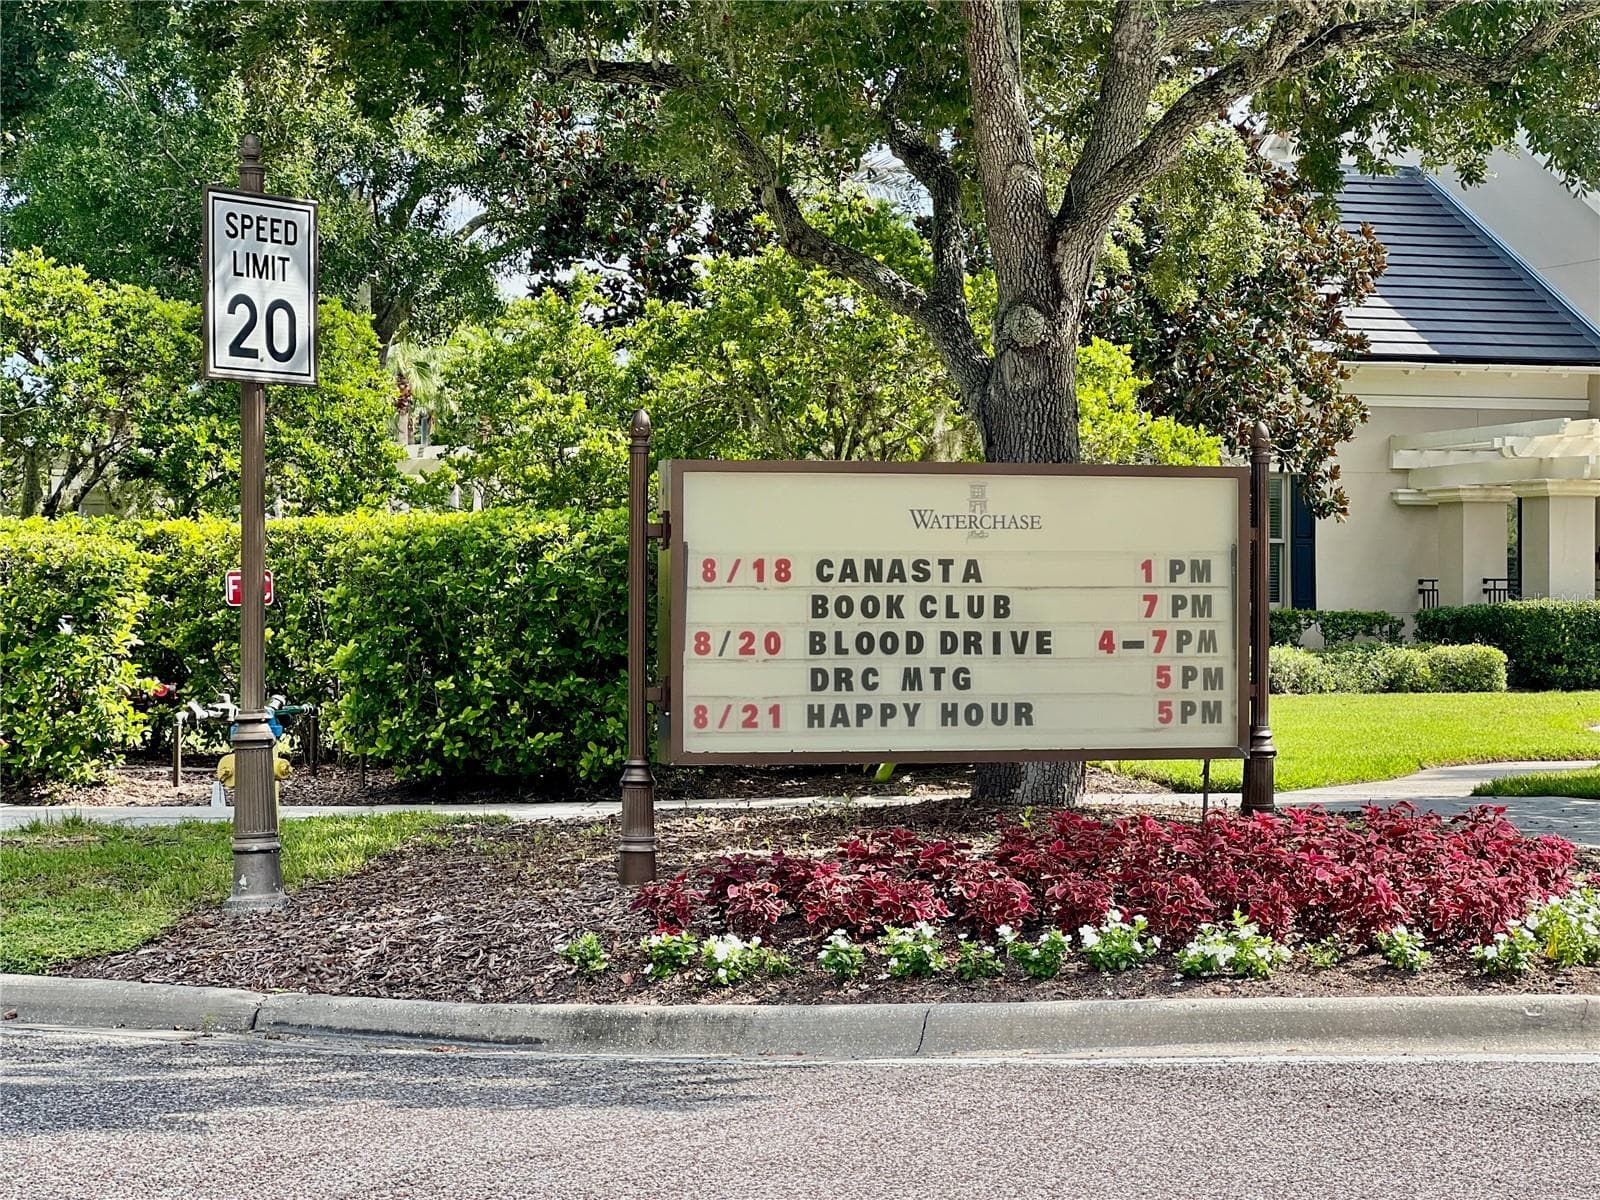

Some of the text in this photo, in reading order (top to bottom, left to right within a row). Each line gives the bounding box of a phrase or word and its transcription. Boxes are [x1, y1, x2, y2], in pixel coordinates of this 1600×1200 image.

[225, 212, 298, 246] SPEED
[232, 250, 290, 282] LIMIT
[227, 293, 297, 363] 20
[815, 558, 983, 584] CANASTA
[1169, 559, 1212, 584] PM
[811, 594, 905, 619] BOOK
[919, 594, 1011, 620] CLUB
[1171, 594, 1213, 619] PM
[693, 630, 782, 657] 8/20
[808, 630, 925, 656] BLOOD
[939, 630, 1053, 656] DRIVE
[810, 666, 880, 693] DRC
[900, 666, 973, 692] MTG
[693, 703, 781, 729] 8/21
[807, 702, 921, 729] HAPPY
[940, 702, 1034, 728] HOUR
